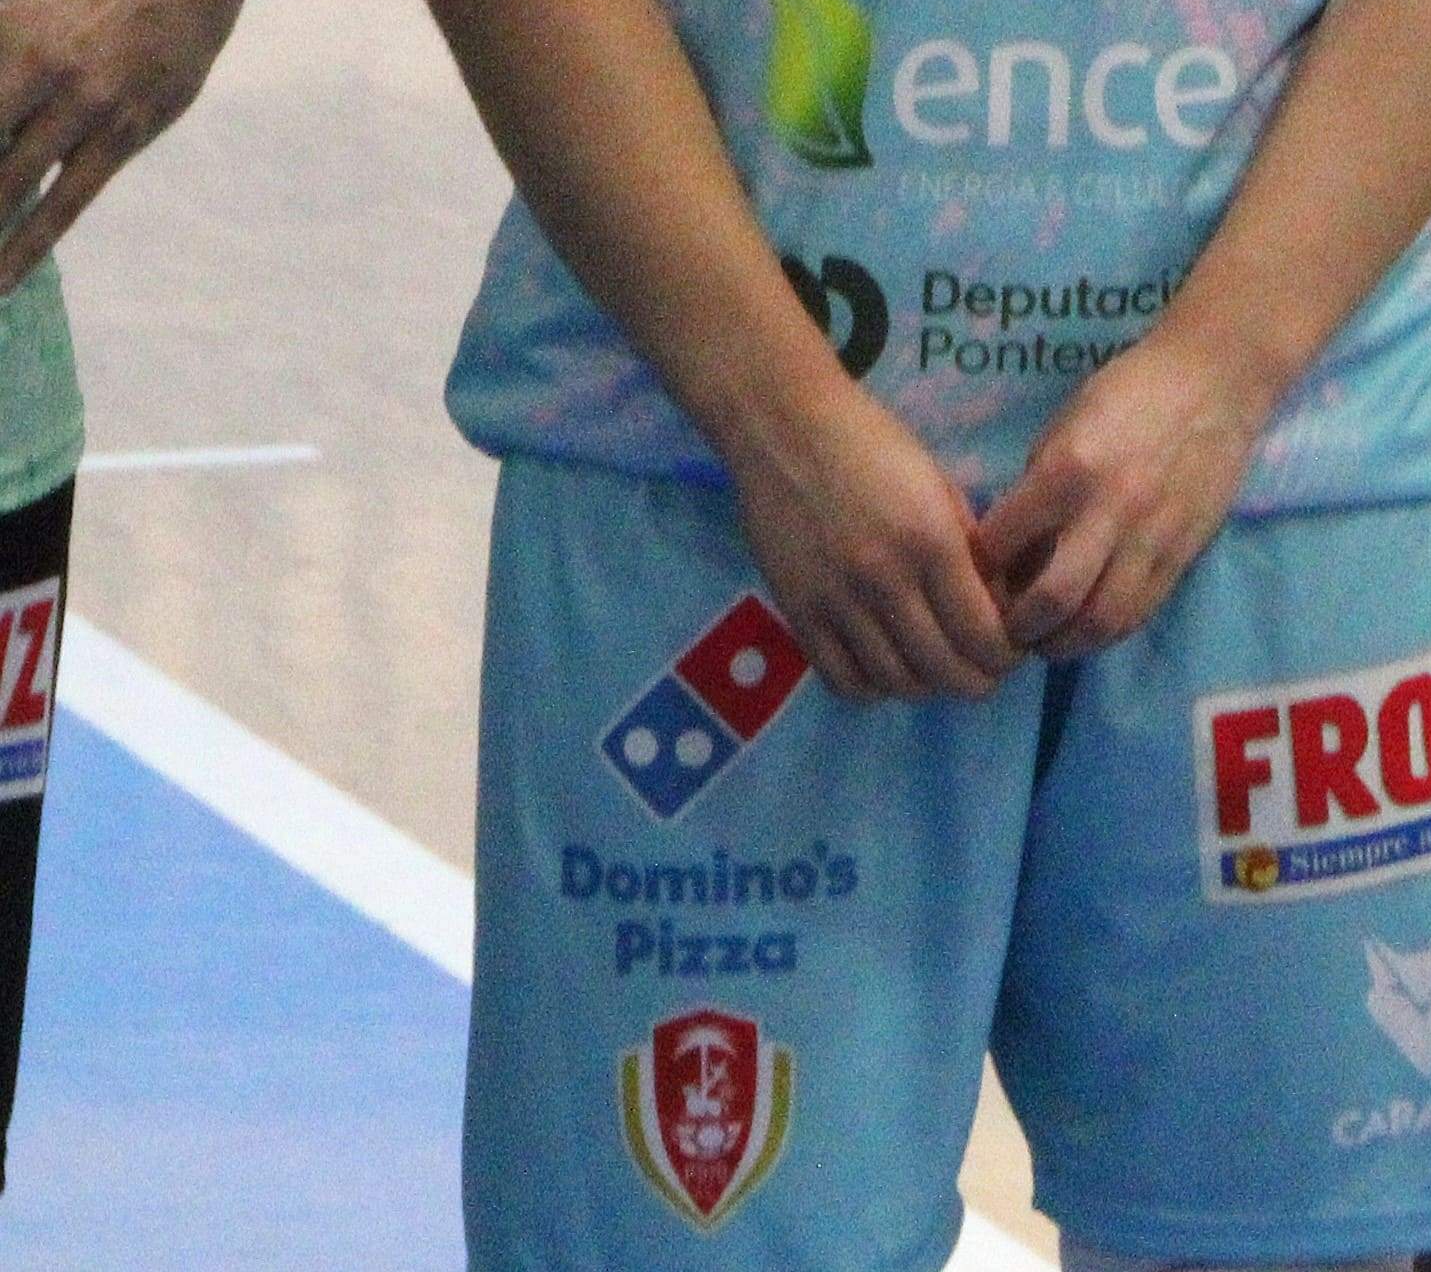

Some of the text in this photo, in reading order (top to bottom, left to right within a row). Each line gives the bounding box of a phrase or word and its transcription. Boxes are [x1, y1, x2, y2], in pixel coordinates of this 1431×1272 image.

[892, 38, 1239, 150] ence
[922, 268, 1172, 332] Deputaci
[919, 333, 1124, 380] Pontev
[559, 843, 860, 906] Domino's
[613, 919, 799, 979] Pizza
